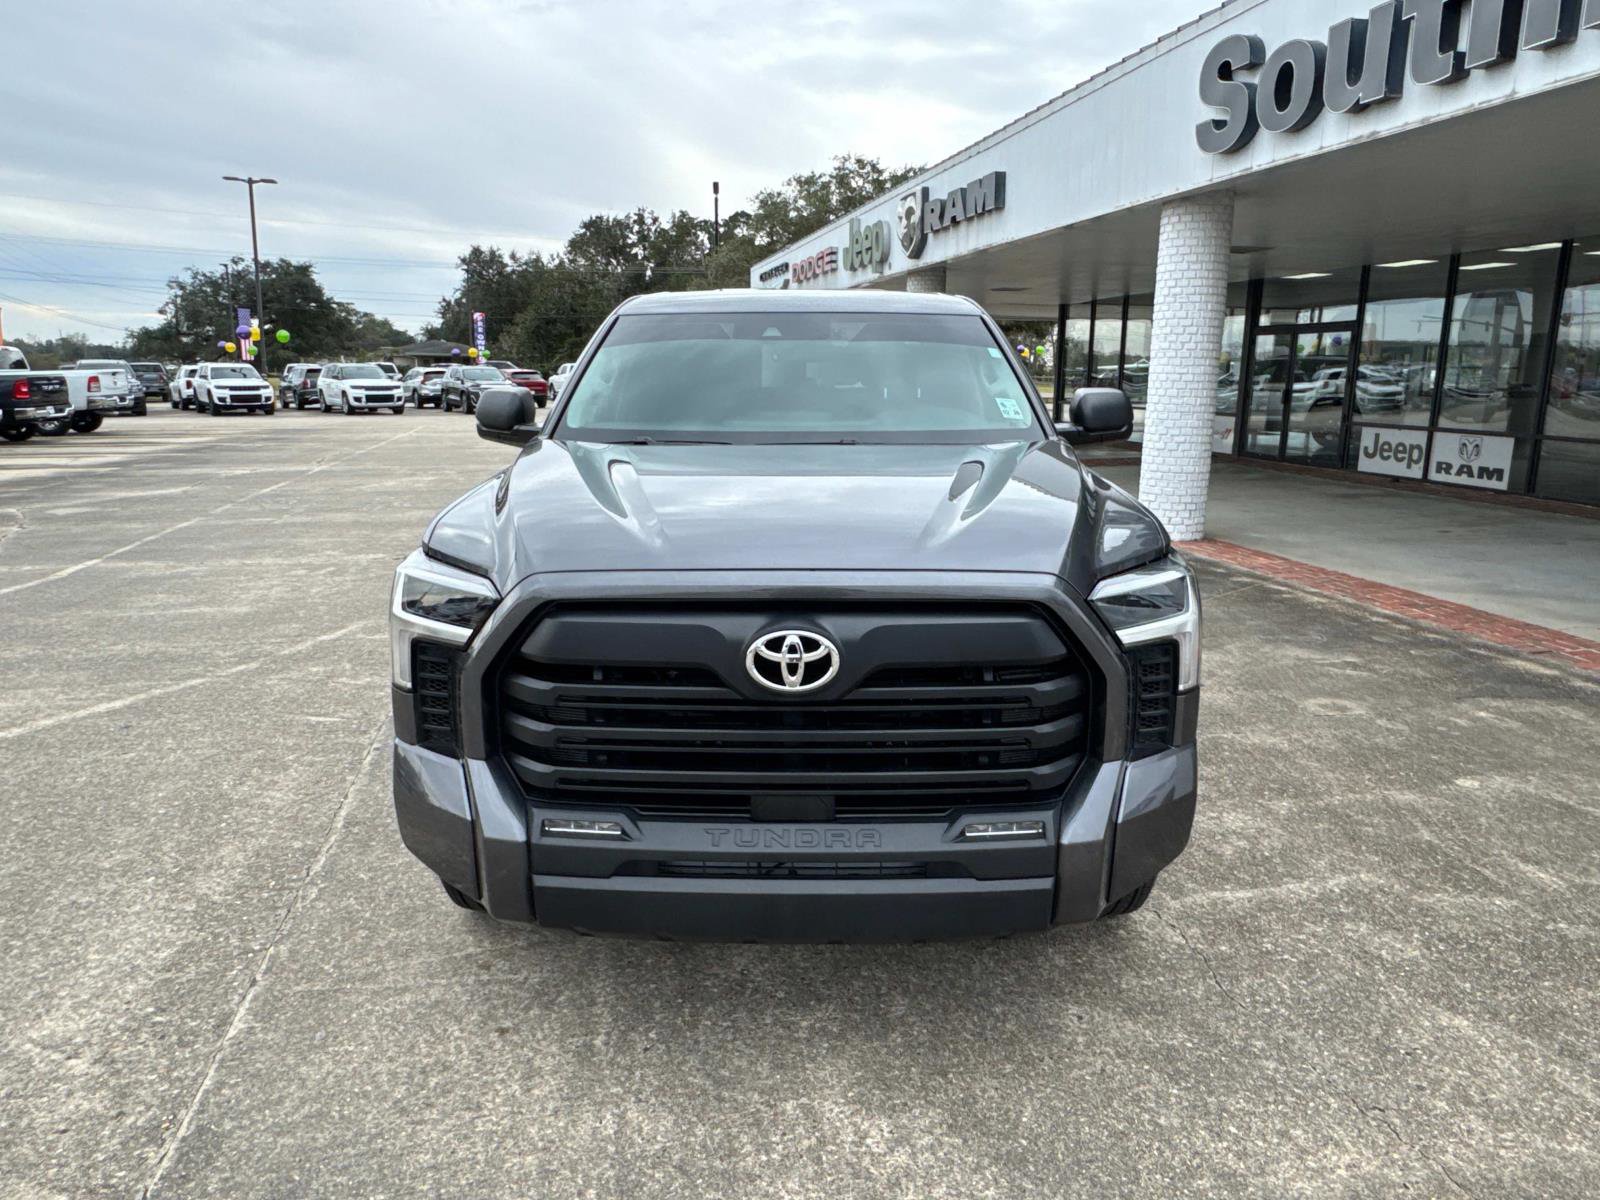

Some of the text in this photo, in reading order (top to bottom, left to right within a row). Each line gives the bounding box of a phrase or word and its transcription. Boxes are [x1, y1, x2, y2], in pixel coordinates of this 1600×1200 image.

[1195, 0, 1600, 154] Sout
[922, 171, 1006, 234] RAM
[843, 216, 891, 273] Jeep
[792, 246, 838, 283] DODGE
[1363, 432, 1424, 469] Jeep
[1435, 461, 1505, 482] RAM
[703, 828, 882, 848] TUNDRA
